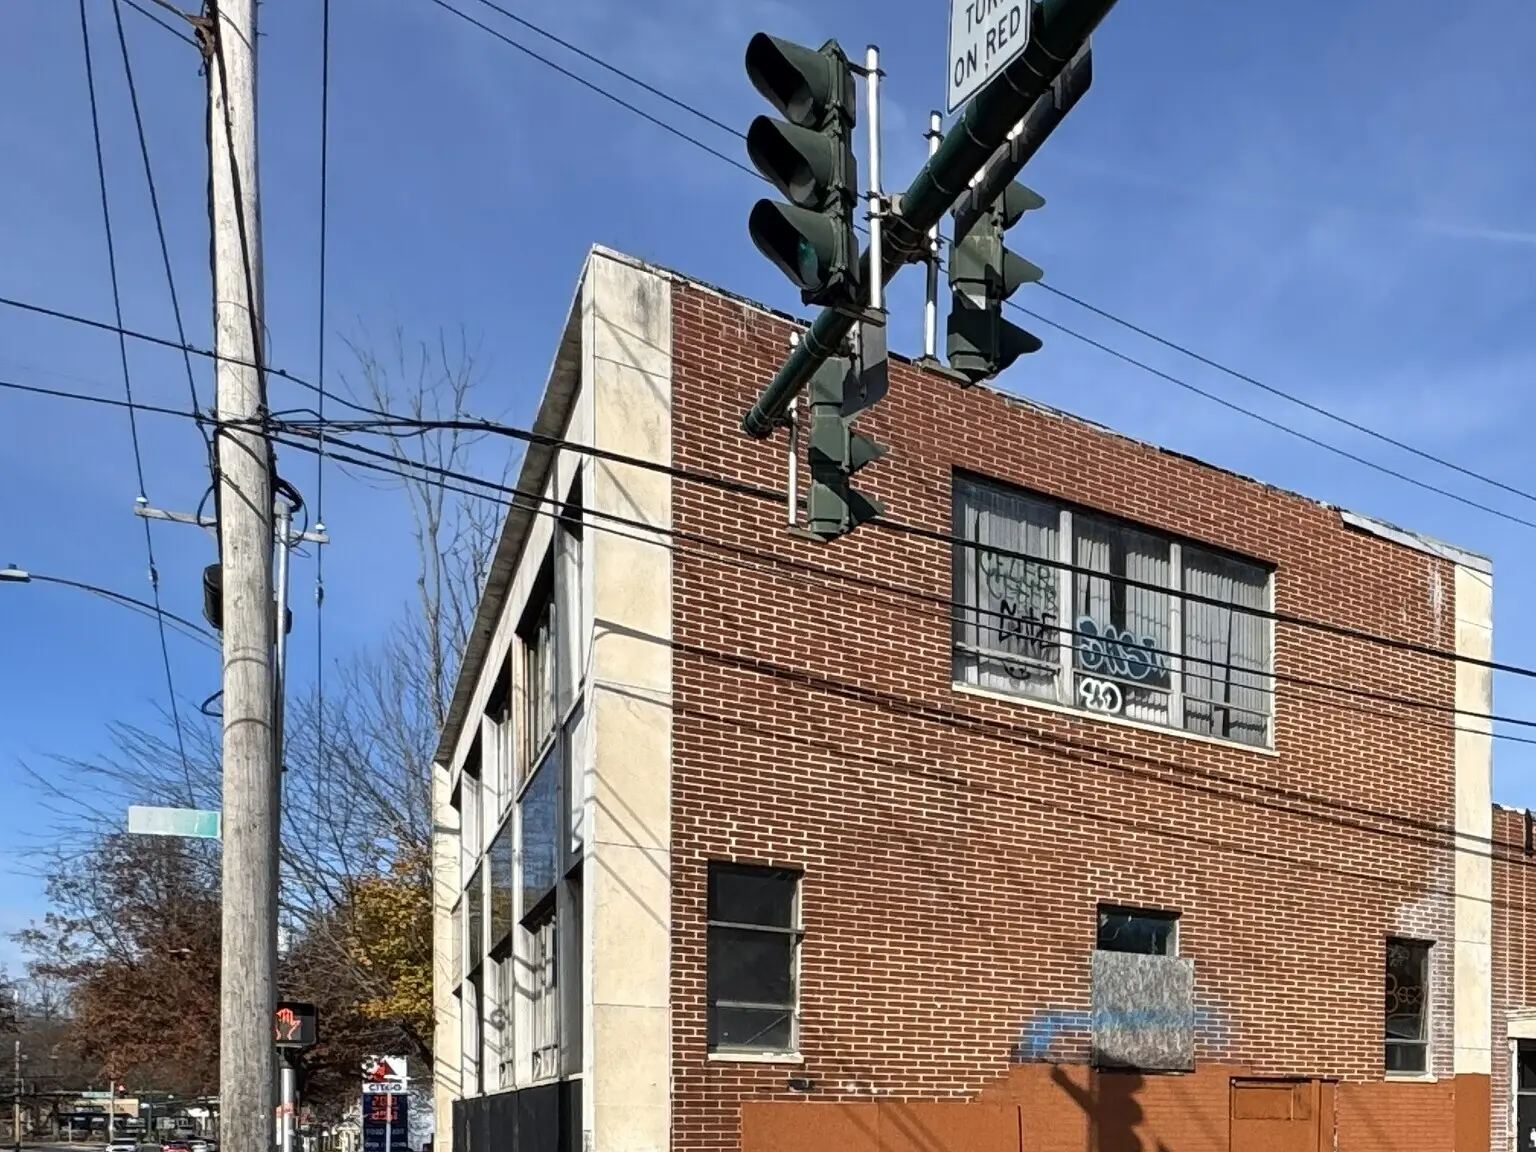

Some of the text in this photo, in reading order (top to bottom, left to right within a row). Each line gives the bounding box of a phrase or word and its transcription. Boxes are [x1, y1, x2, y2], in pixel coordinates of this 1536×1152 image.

[955, 5, 1020, 87] ON RED
[368, 1083, 402, 1091] CITGO
